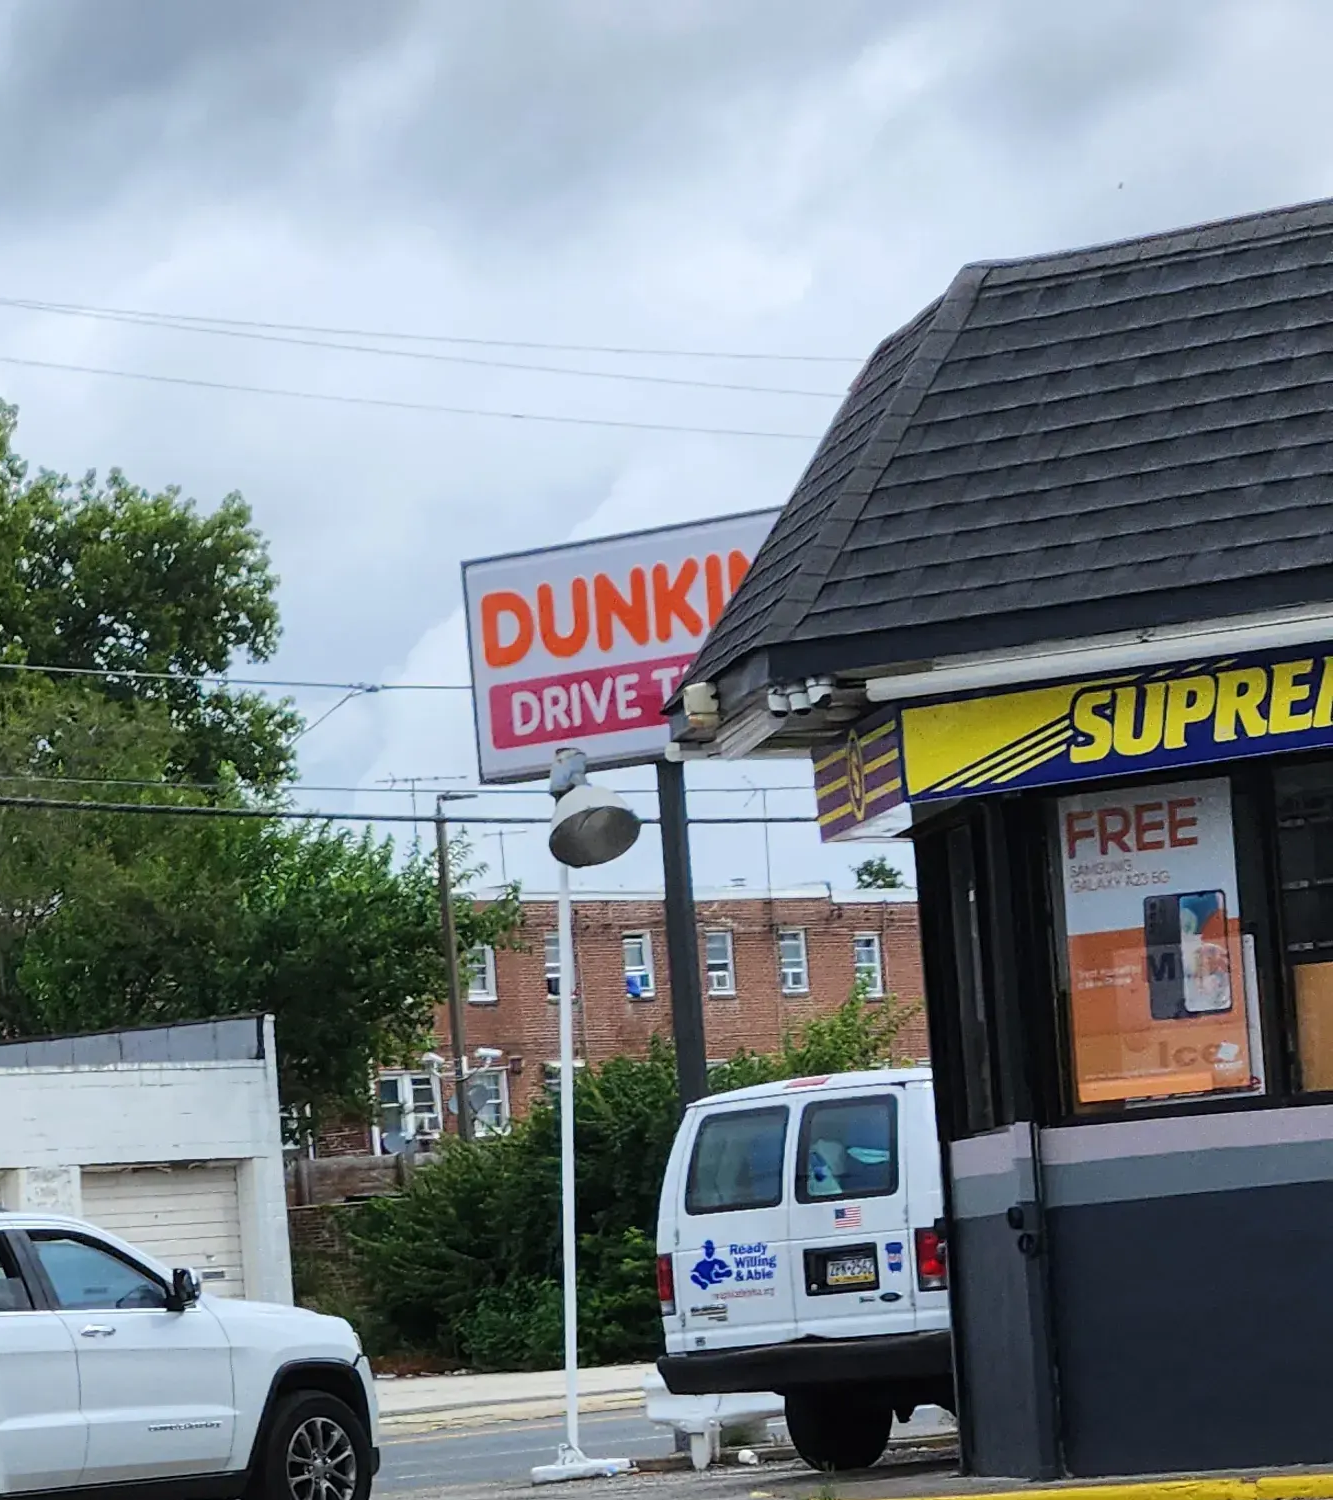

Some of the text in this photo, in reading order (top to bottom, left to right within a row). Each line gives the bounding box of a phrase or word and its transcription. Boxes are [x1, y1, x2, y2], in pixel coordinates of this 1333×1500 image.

[510, 672, 642, 737] DRIVE
[1065, 797, 1198, 859] FREE
[1151, 870, 1170, 885] 5G
[730, 1242, 767, 1255] Ready
[734, 1255, 777, 1268] Willing
[734, 1269, 773, 1281] & Able
